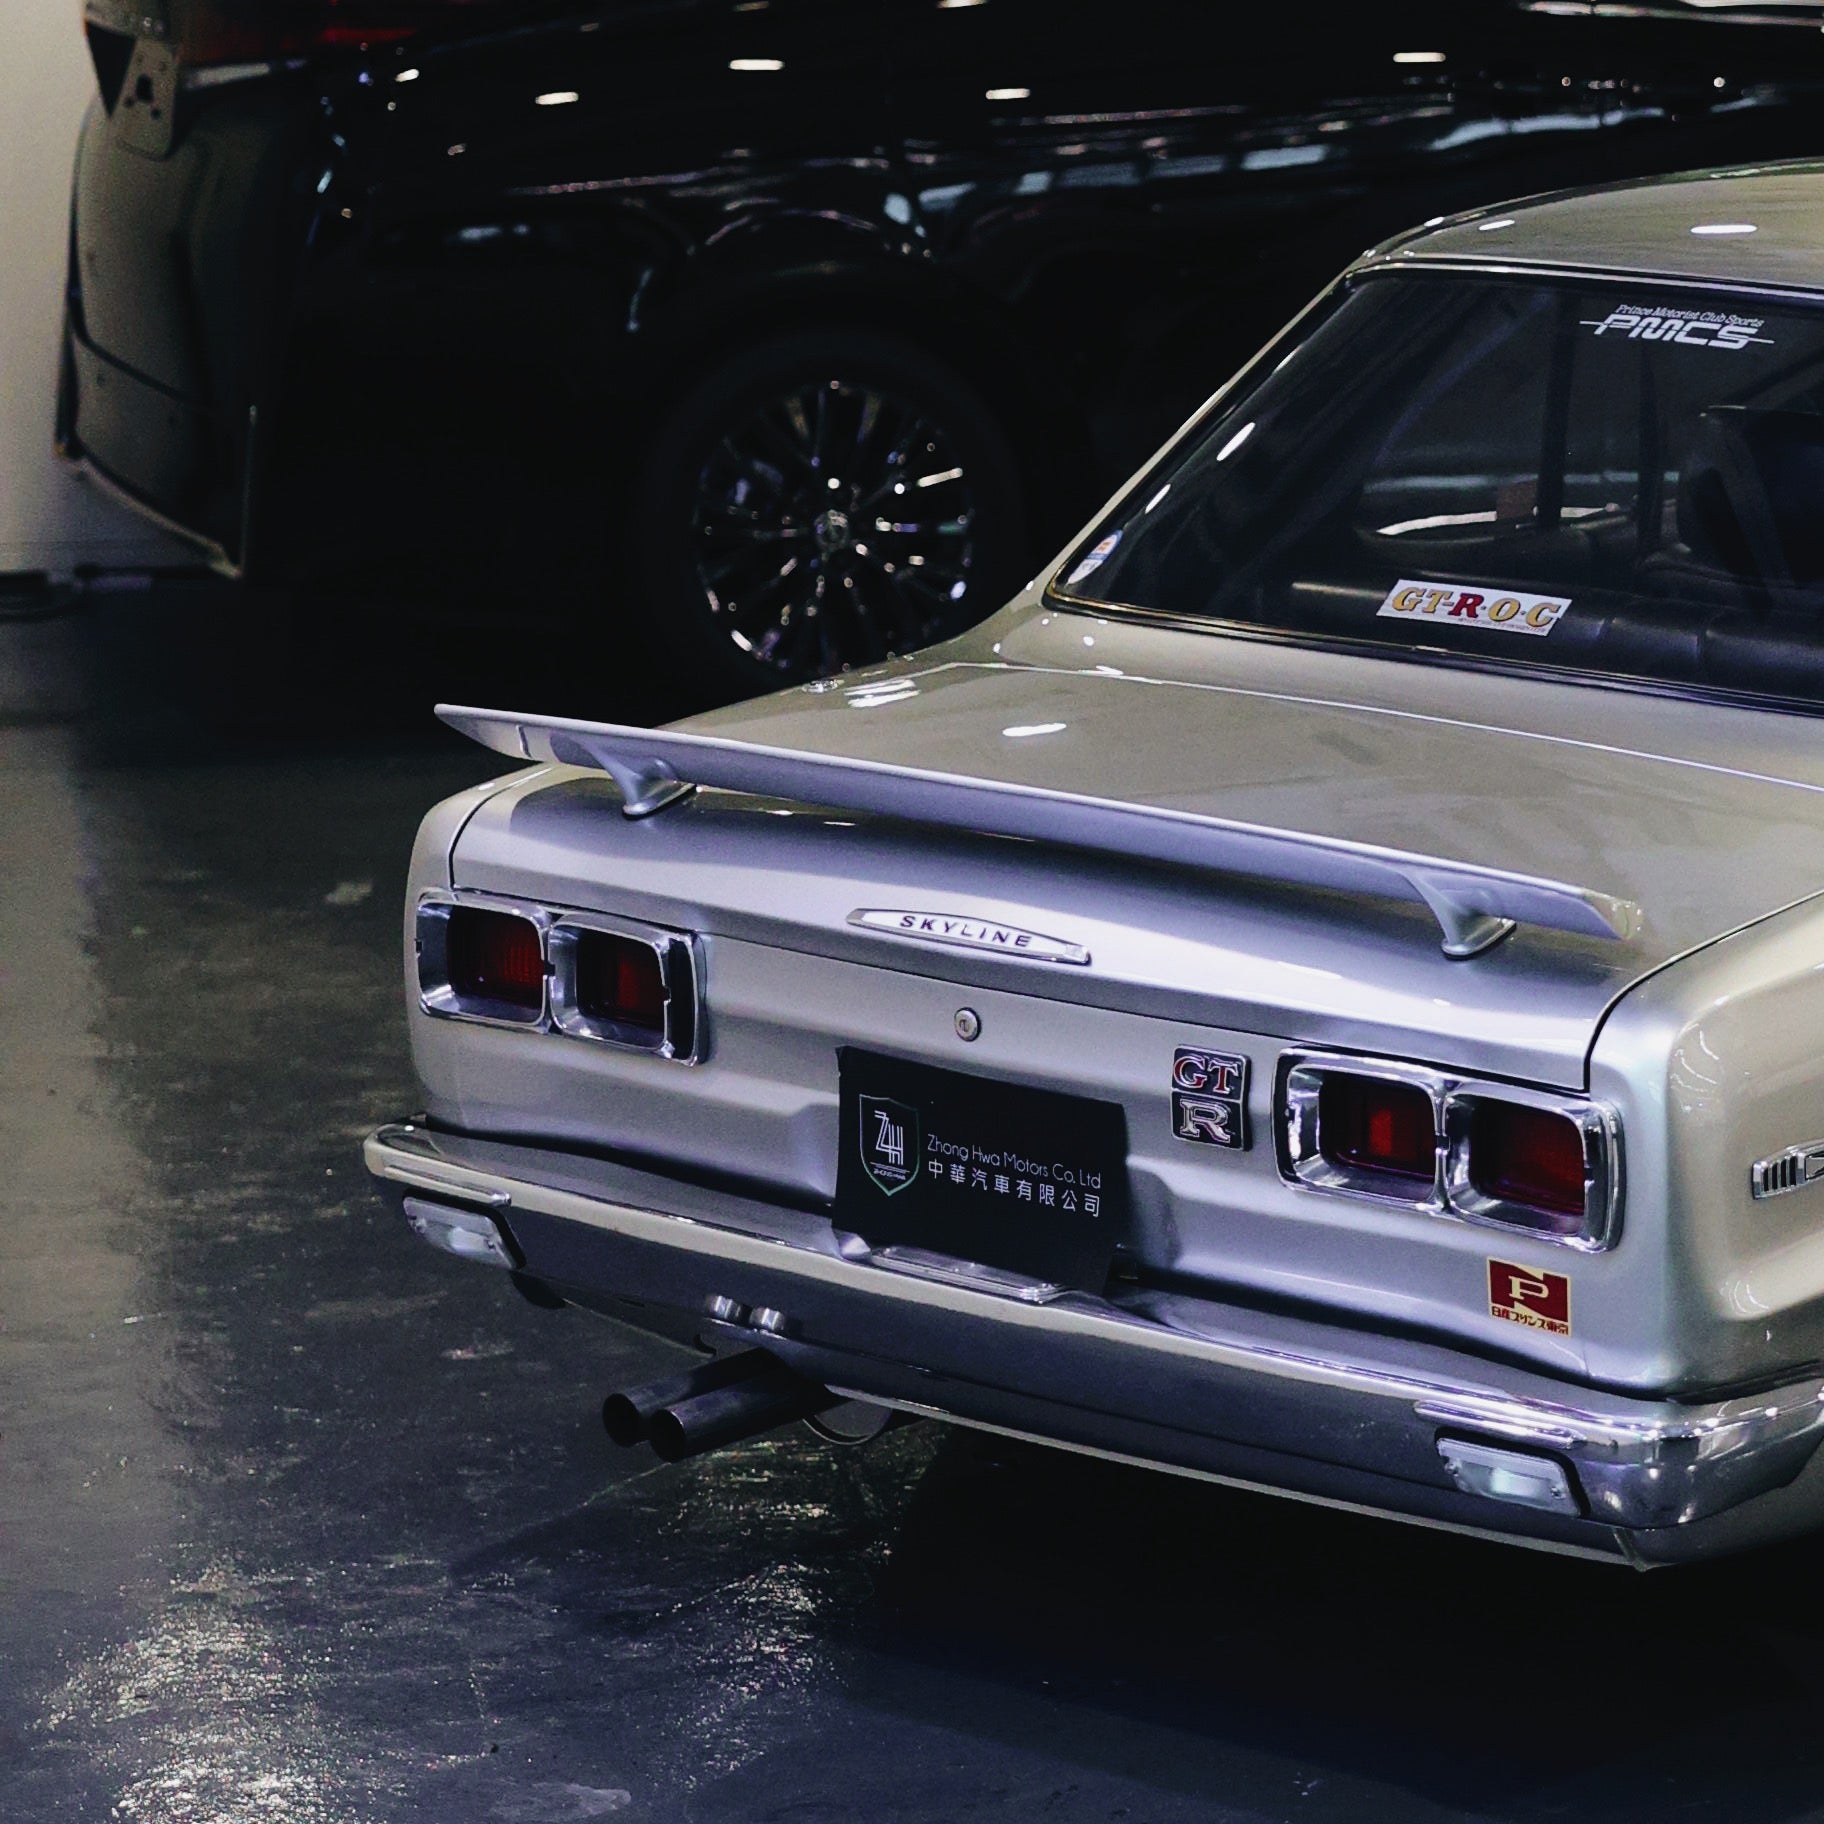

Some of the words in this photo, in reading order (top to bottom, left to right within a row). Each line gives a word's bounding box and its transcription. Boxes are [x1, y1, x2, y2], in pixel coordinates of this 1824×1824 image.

[1592, 313, 1760, 350] PMCS
[1615, 304, 1653, 316] Prince
[1653, 307, 1701, 320] Motorist
[1700, 311, 1726, 323] Club
[1725, 314, 1765, 328] Sports
[899, 915, 1033, 948] SKYLINE
[1173, 1054, 1239, 1094] GT
[1180, 1098, 1231, 1144] R
[927, 1133, 969, 1162] Zhong
[972, 1144, 1001, 1168] Hwa
[1003, 1150, 1049, 1178] Motors
[1052, 1162, 1077, 1185] Co.
[1079, 1168, 1102, 1190] Ltd
[927, 1158, 1101, 1218] 中華汽車有限公司
